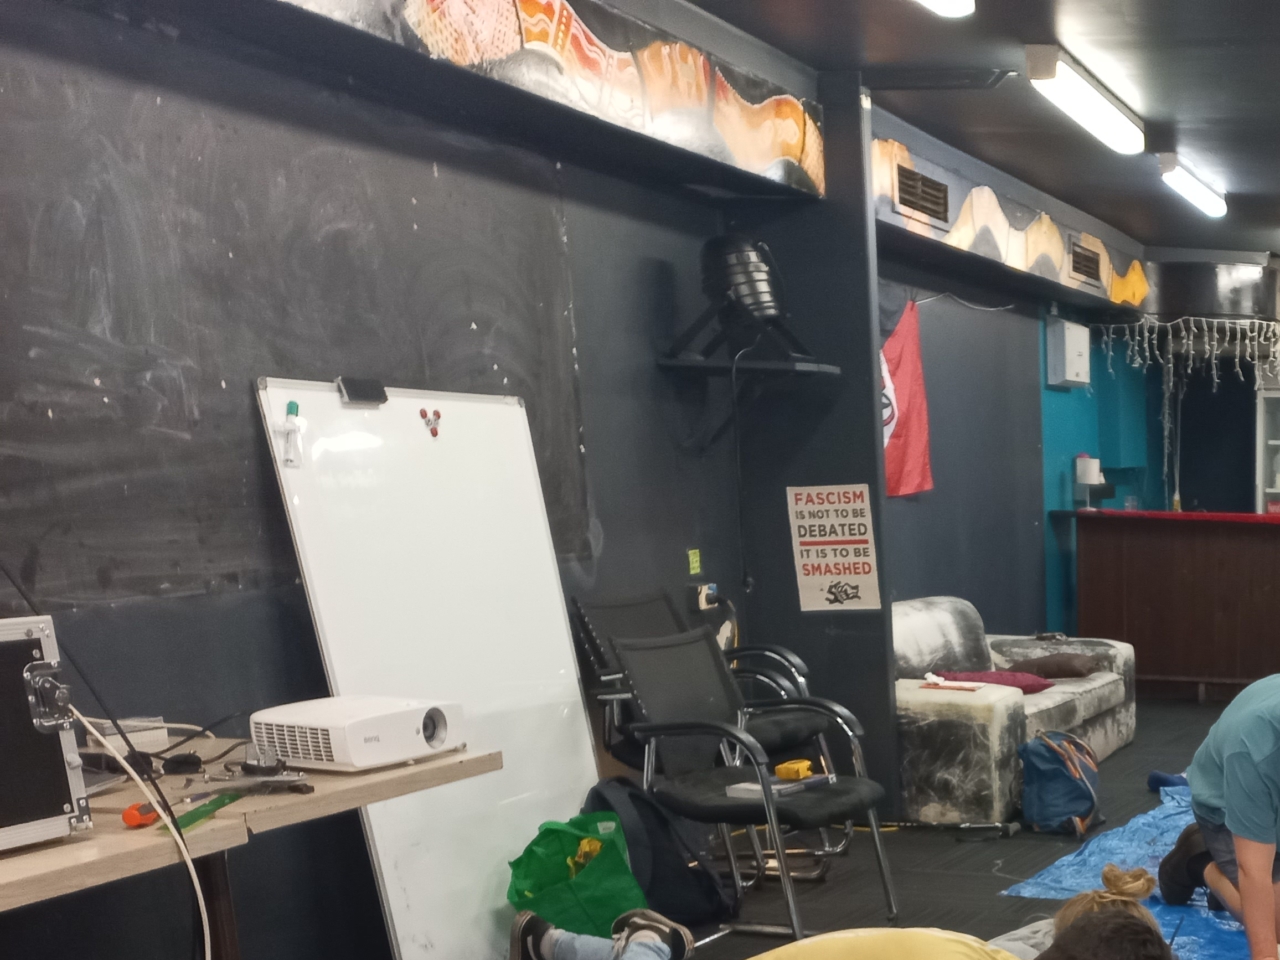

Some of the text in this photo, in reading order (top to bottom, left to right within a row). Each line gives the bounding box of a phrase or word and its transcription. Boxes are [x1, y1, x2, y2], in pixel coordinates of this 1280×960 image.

[793, 490, 865, 506] FASCISM
[795, 508, 866, 520] IS NOT TO BE
[797, 522, 868, 538] DEBATED
[800, 547, 870, 559] IT IS TO BE
[802, 561, 872, 577] SMASHED
